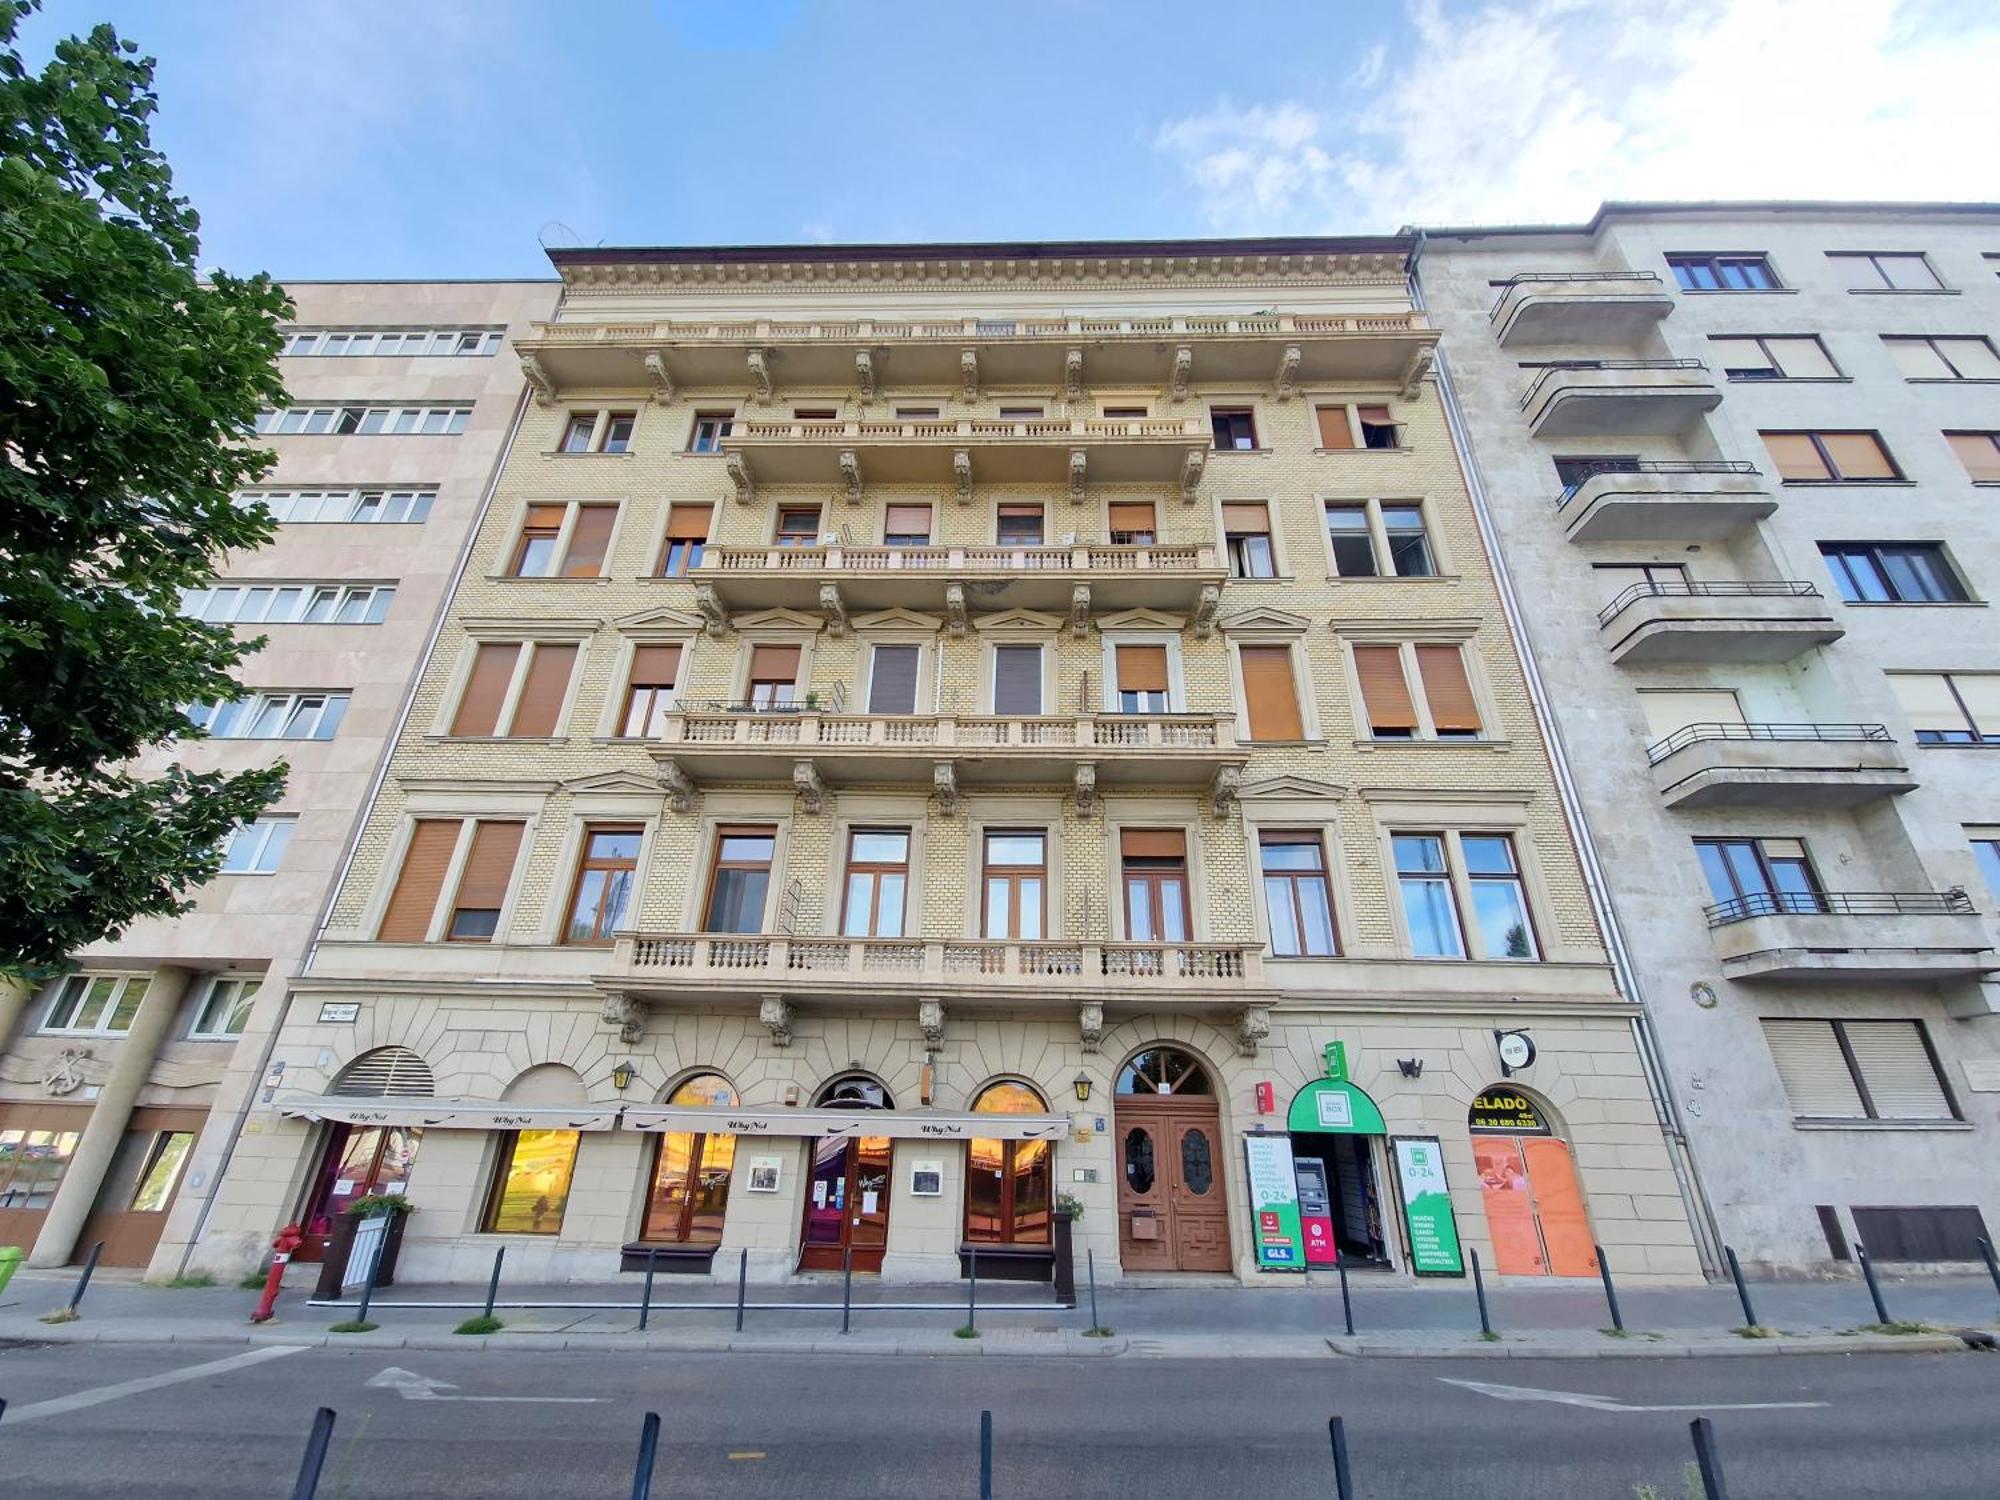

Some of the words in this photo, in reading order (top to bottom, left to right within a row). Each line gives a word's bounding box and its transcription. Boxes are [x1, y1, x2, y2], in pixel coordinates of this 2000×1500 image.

[727, 1120, 750, 1131] Why
[749, 1120, 768, 1130] Not
[920, 1125, 944, 1136] Why
[1260, 1190, 1288, 1201] 0-24
[1311, 1239, 1327, 1247] ATM
